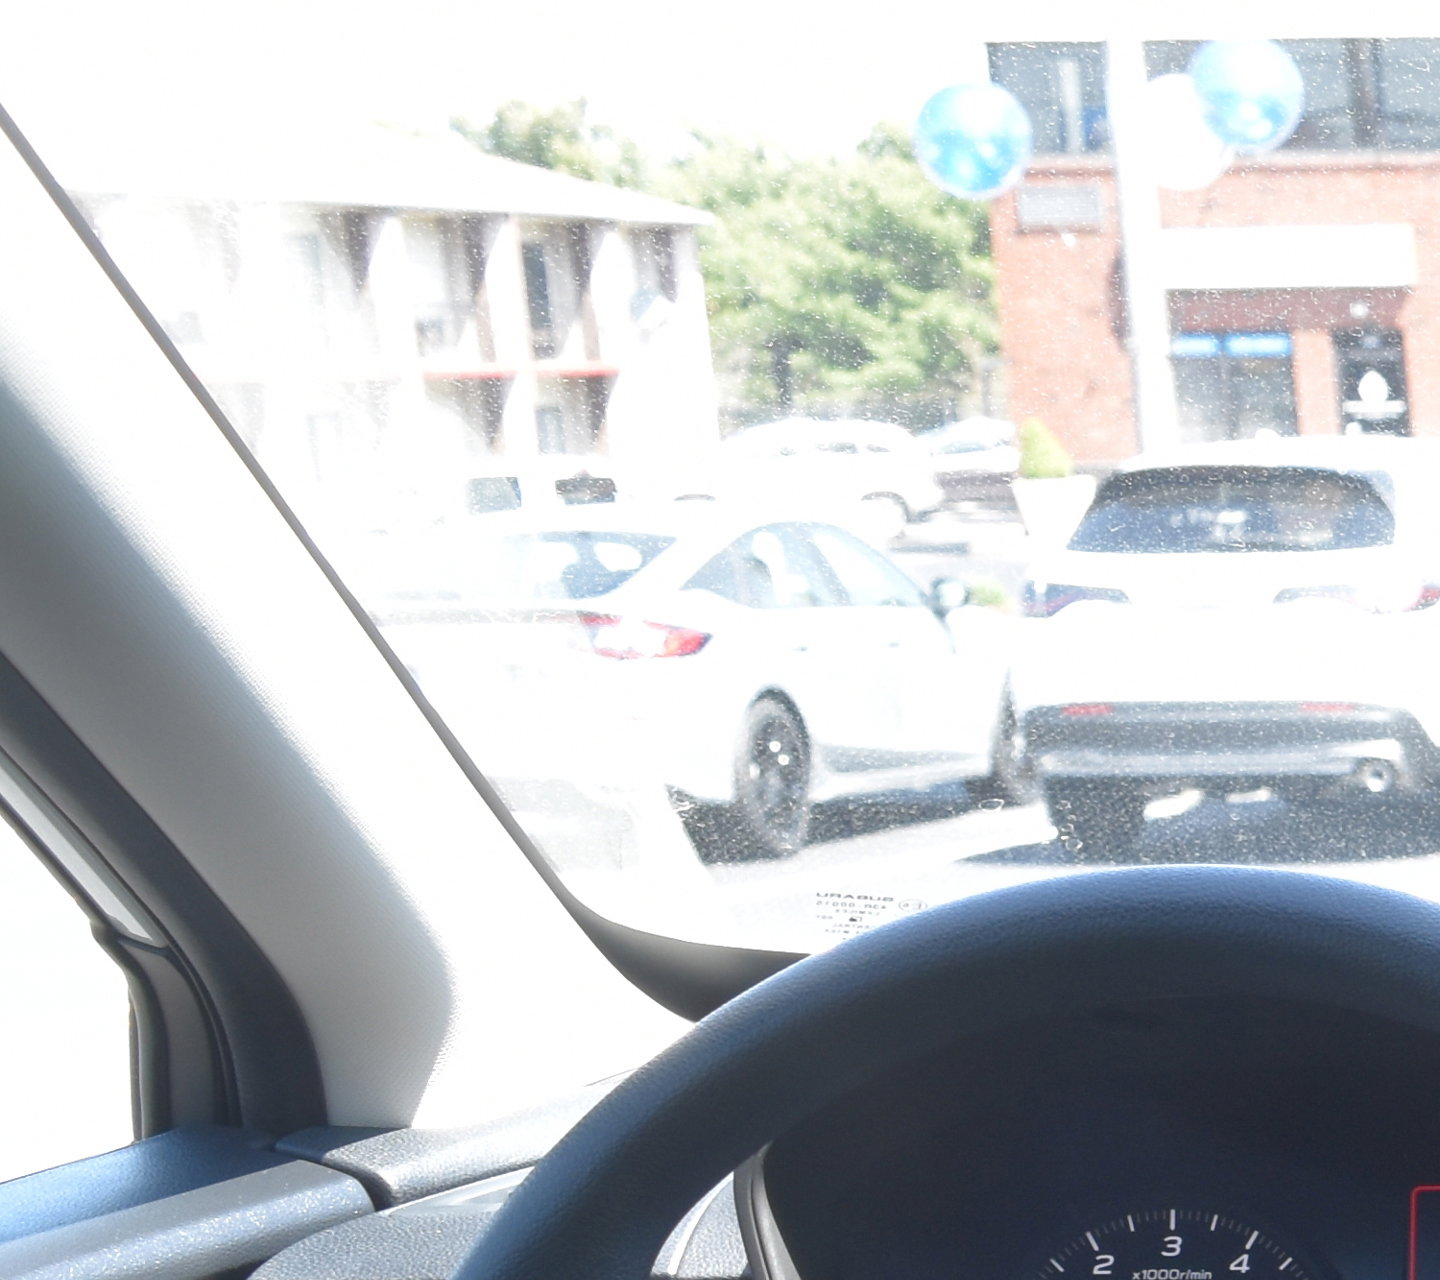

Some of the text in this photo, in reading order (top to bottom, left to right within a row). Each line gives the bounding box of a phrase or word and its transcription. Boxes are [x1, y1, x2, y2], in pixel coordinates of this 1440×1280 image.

[1161, 1236, 1182, 1257] 3
[1093, 1255, 1115, 1275] 2
[1229, 1253, 1250, 1273] 4
